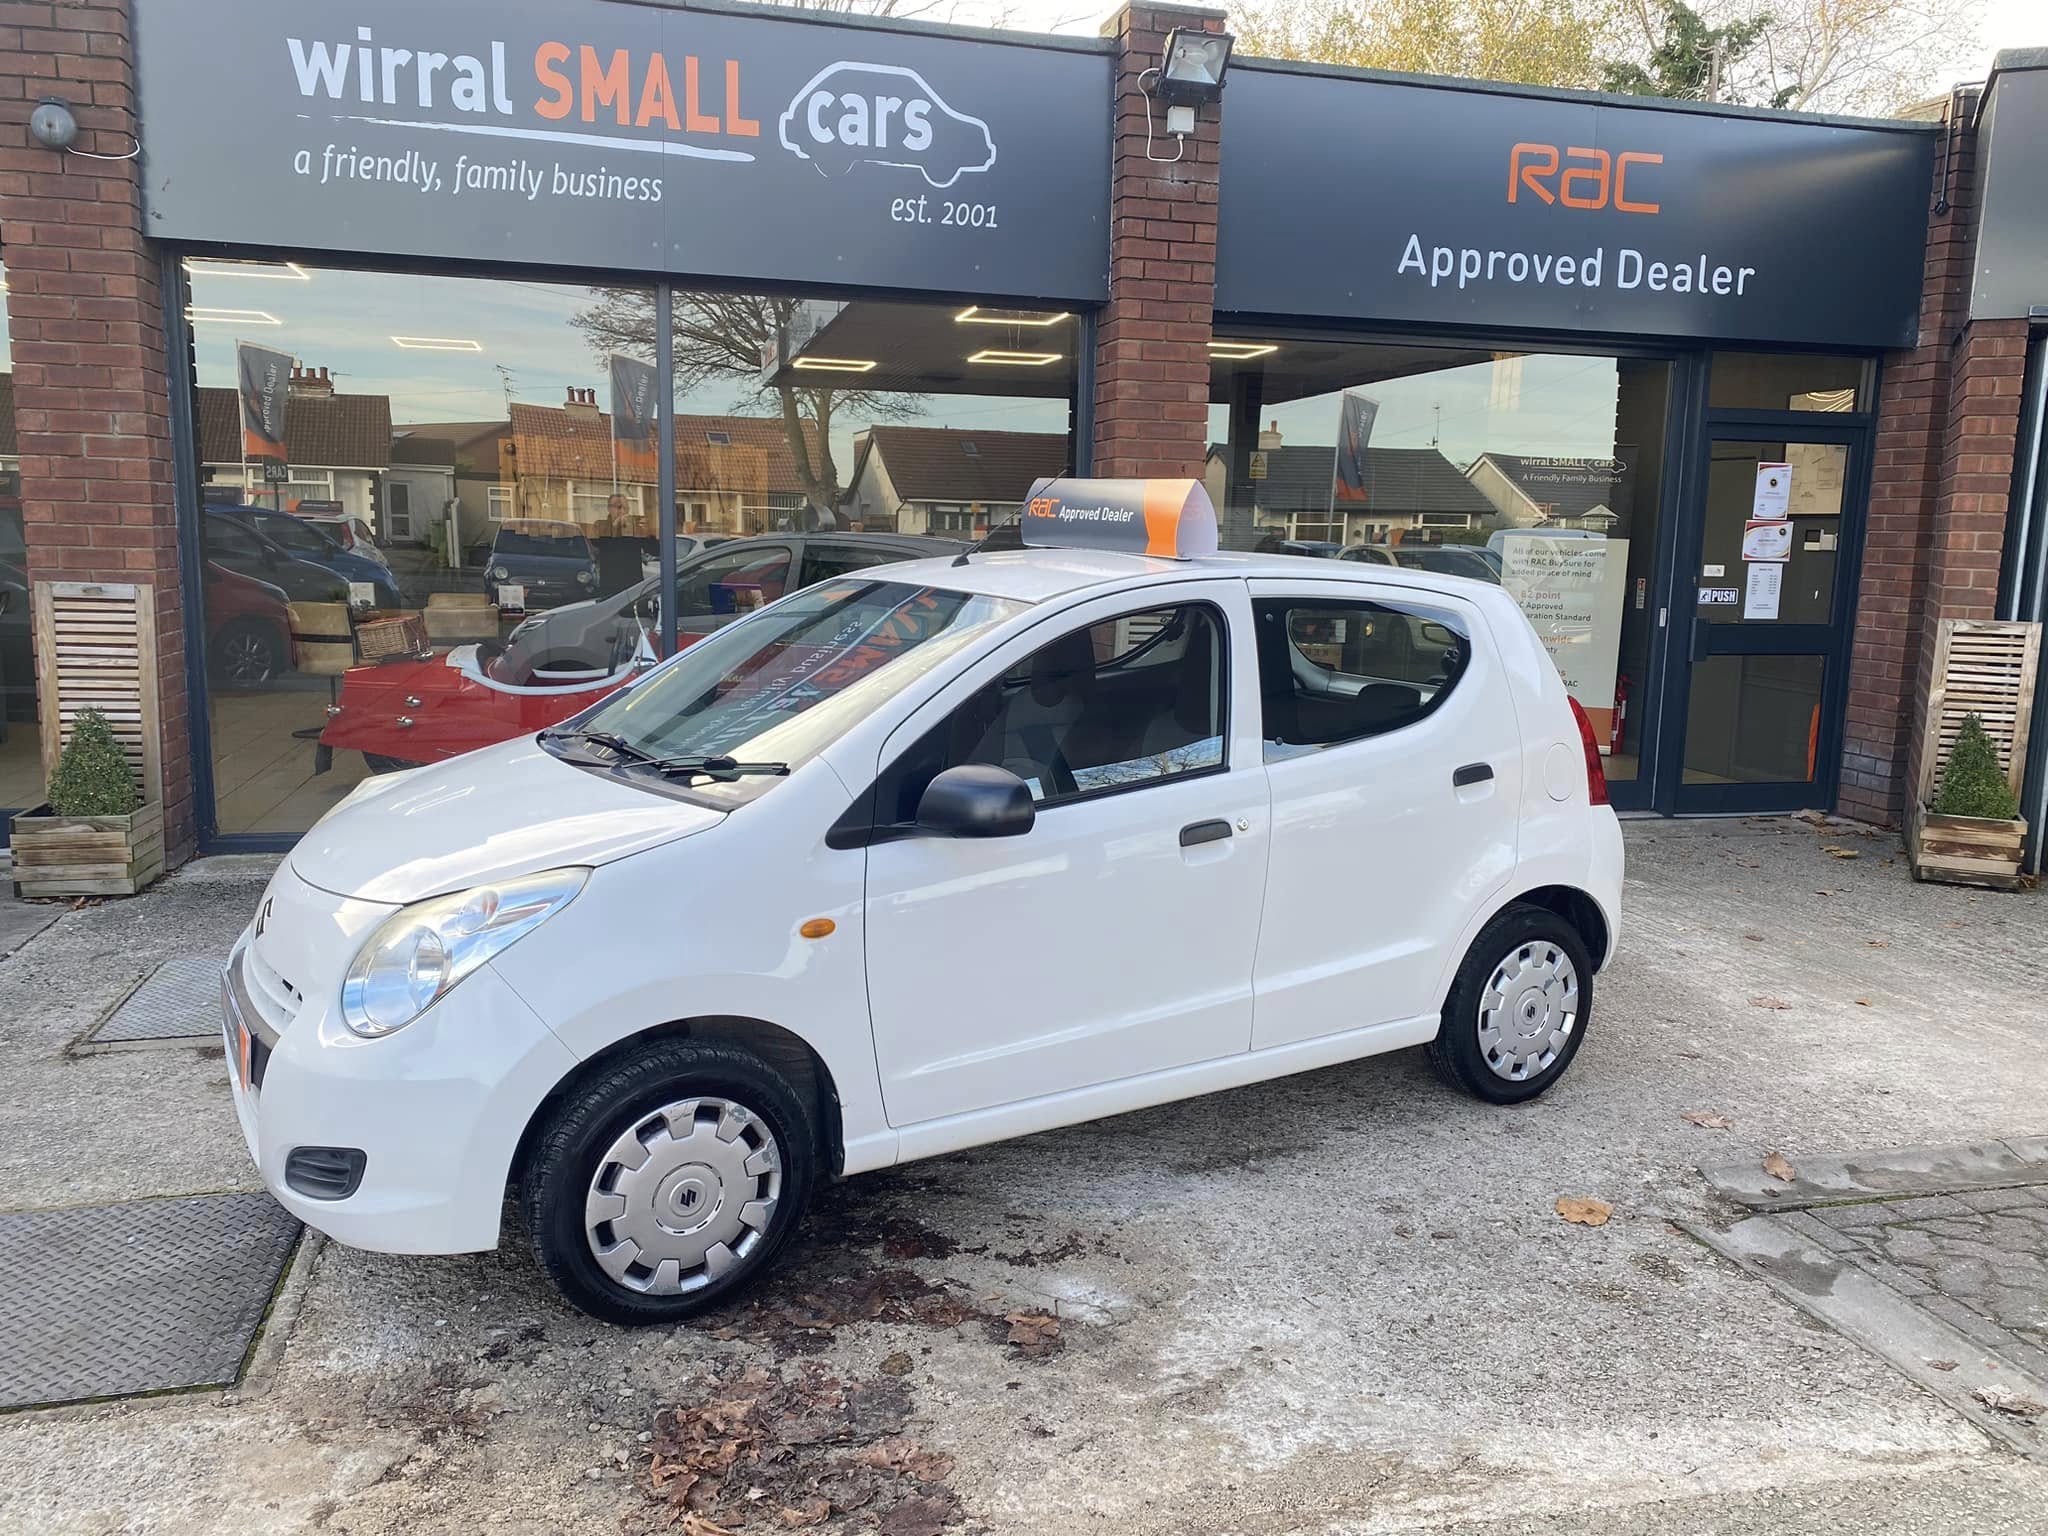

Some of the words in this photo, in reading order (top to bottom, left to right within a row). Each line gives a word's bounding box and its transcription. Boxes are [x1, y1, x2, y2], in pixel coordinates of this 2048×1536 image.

[286, 26, 513, 116] wirral
[533, 41, 760, 137] SMALL
[807, 90, 934, 152] cars
[293, 151, 311, 176] a
[320, 144, 442, 192] friendly,
[452, 155, 544, 201] family
[552, 165, 663, 203] business
[891, 194, 932, 224] est.
[941, 201, 999, 229] 2001
[1397, 233, 1604, 289] Approved
[1616, 248, 1757, 296] Dealer
[1520, 457, 1550, 466] wirral
[1552, 457, 1587, 468] SMALL
[1594, 459, 1616, 468] cars
[1530, 474, 1561, 483] Friendly
[1562, 474, 1588, 484] Family
[1589, 474, 1622, 483] Business
[1059, 505, 1101, 523] Approved
[1101, 506, 1135, 523] Dealer
[1530, 558, 1547, 566] RAC
[1583, 560, 1596, 568] for
[1536, 591, 1561, 600] point
[1711, 590, 1736, 602] PUSH
[1526, 602, 1563, 611] Approved
[1555, 614, 1592, 622] Standard
